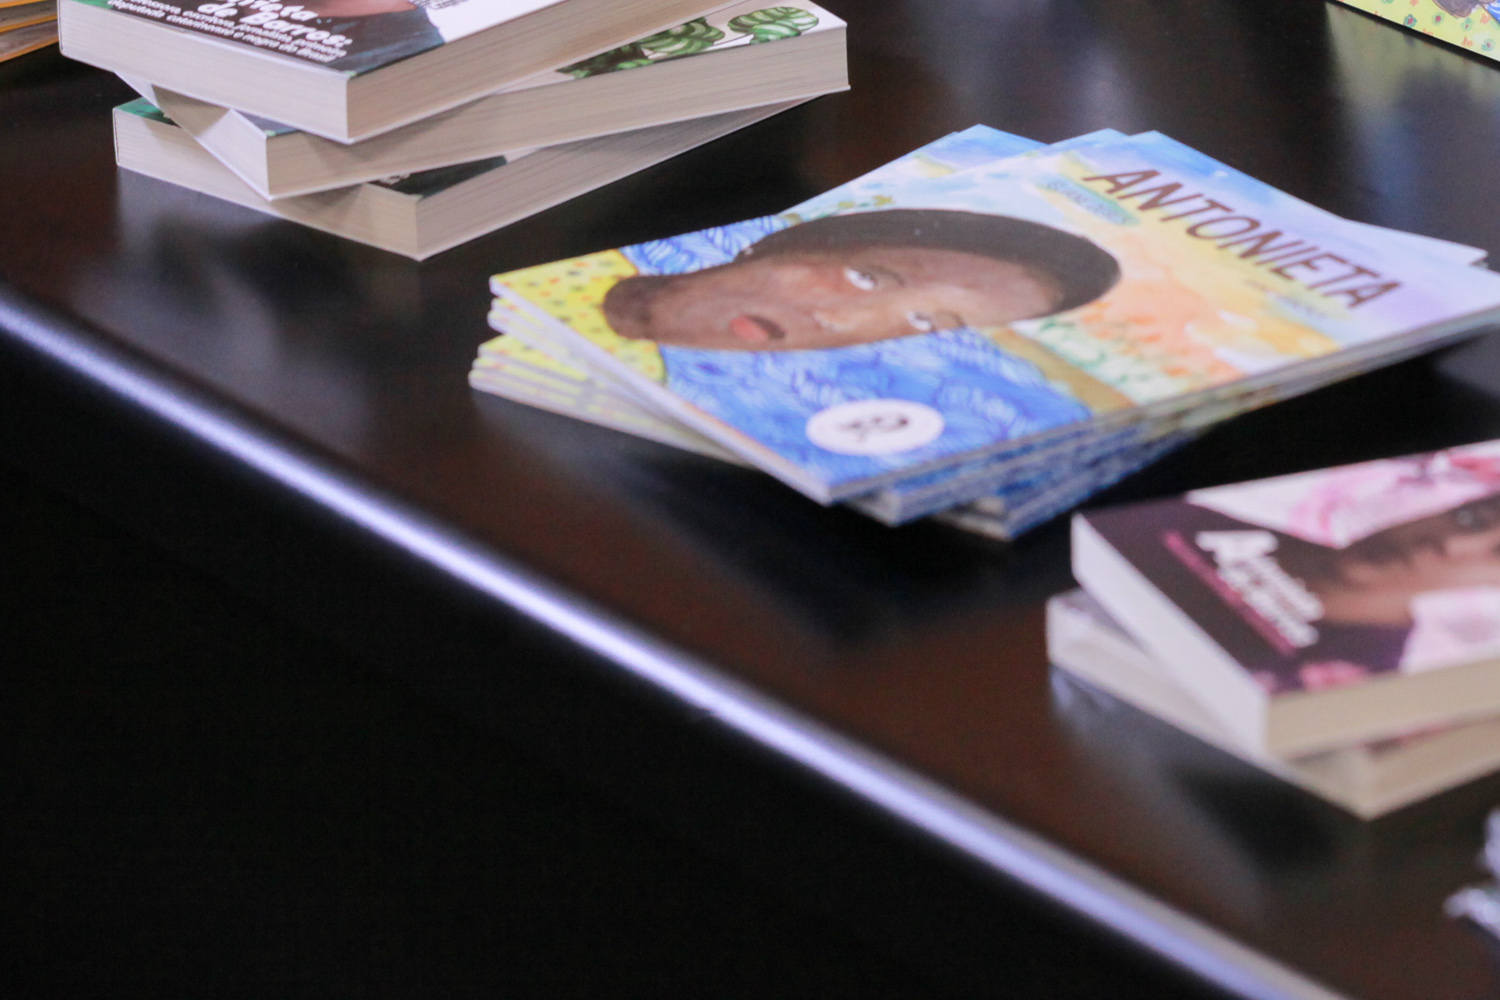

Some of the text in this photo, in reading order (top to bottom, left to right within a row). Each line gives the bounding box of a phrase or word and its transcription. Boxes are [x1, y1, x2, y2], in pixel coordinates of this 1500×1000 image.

[198, 1, 352, 48] de Barros:
[1081, 169, 1403, 310] ANTONIETA
